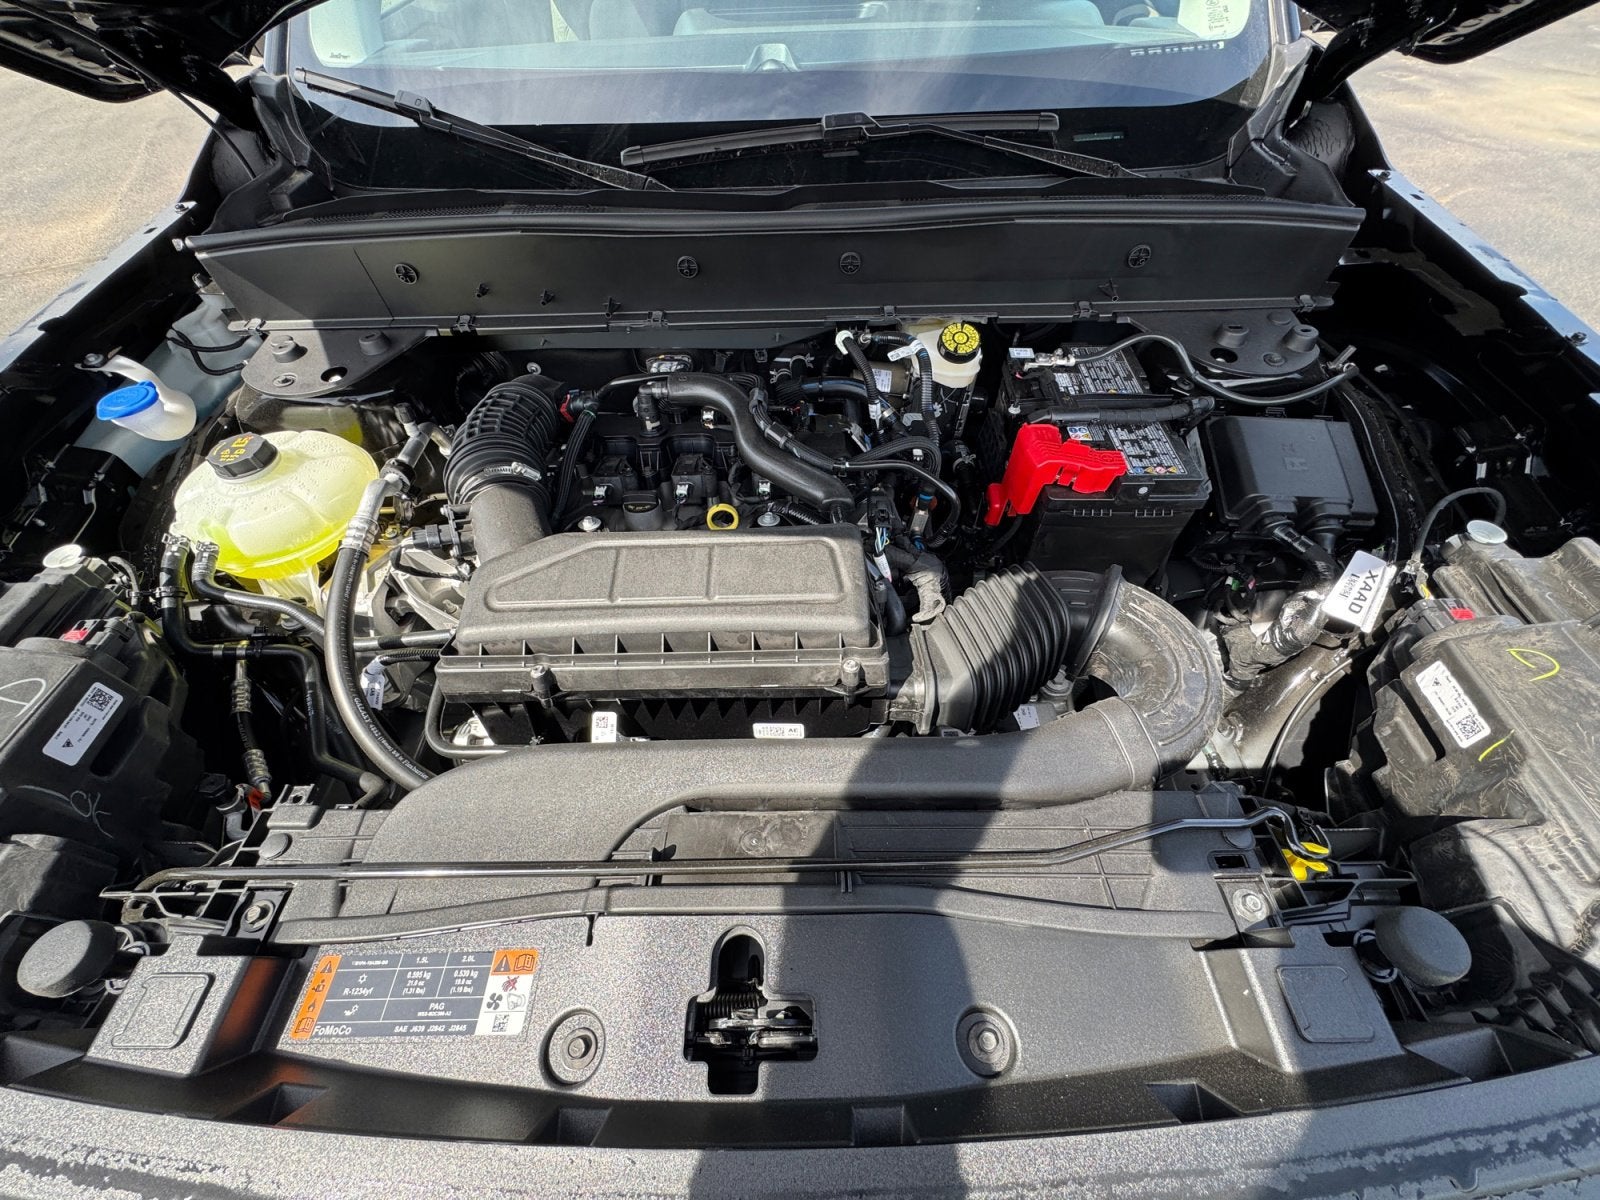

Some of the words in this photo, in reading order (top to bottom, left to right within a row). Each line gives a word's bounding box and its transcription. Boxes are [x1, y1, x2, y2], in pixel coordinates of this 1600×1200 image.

[1349, 570, 1379, 614] XAAD
[354, 697, 373, 722] GALAXY
[462, 955, 476, 963] 2.0L
[423, 971, 432, 980] kg
[470, 969, 479, 979] kg
[342, 987, 375, 996] R-1234yf
[428, 1002, 445, 1010] PAG
[312, 1025, 352, 1036] FoMoCo
[394, 1025, 408, 1033] SAE
[409, 1025, 426, 1033] J639
